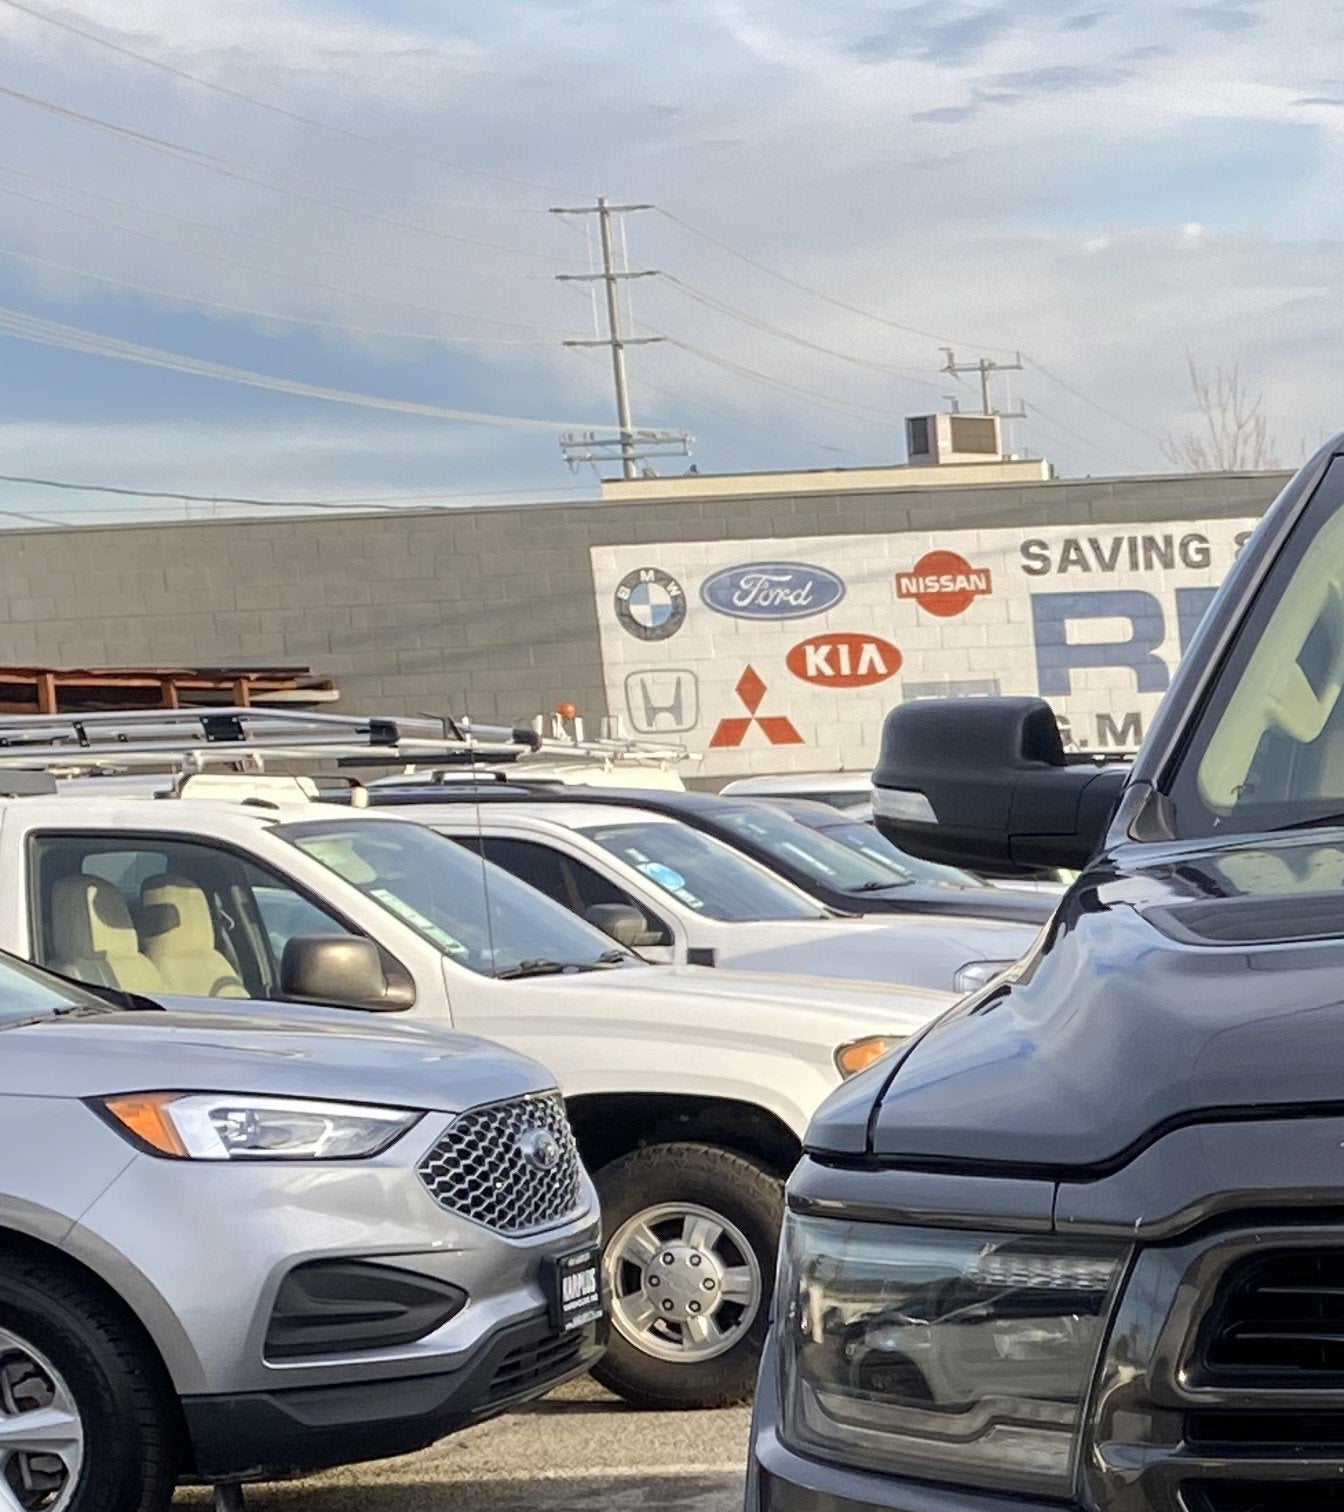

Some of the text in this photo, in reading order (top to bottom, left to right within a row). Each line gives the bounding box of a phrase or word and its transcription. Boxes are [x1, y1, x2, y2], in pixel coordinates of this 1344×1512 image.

[1019, 533, 1212, 577] SAVING
[616, 569, 682, 601] BMW
[732, 573, 813, 608] Ford
[900, 573, 987, 595] NISSAN
[804, 643, 888, 677] KIA
